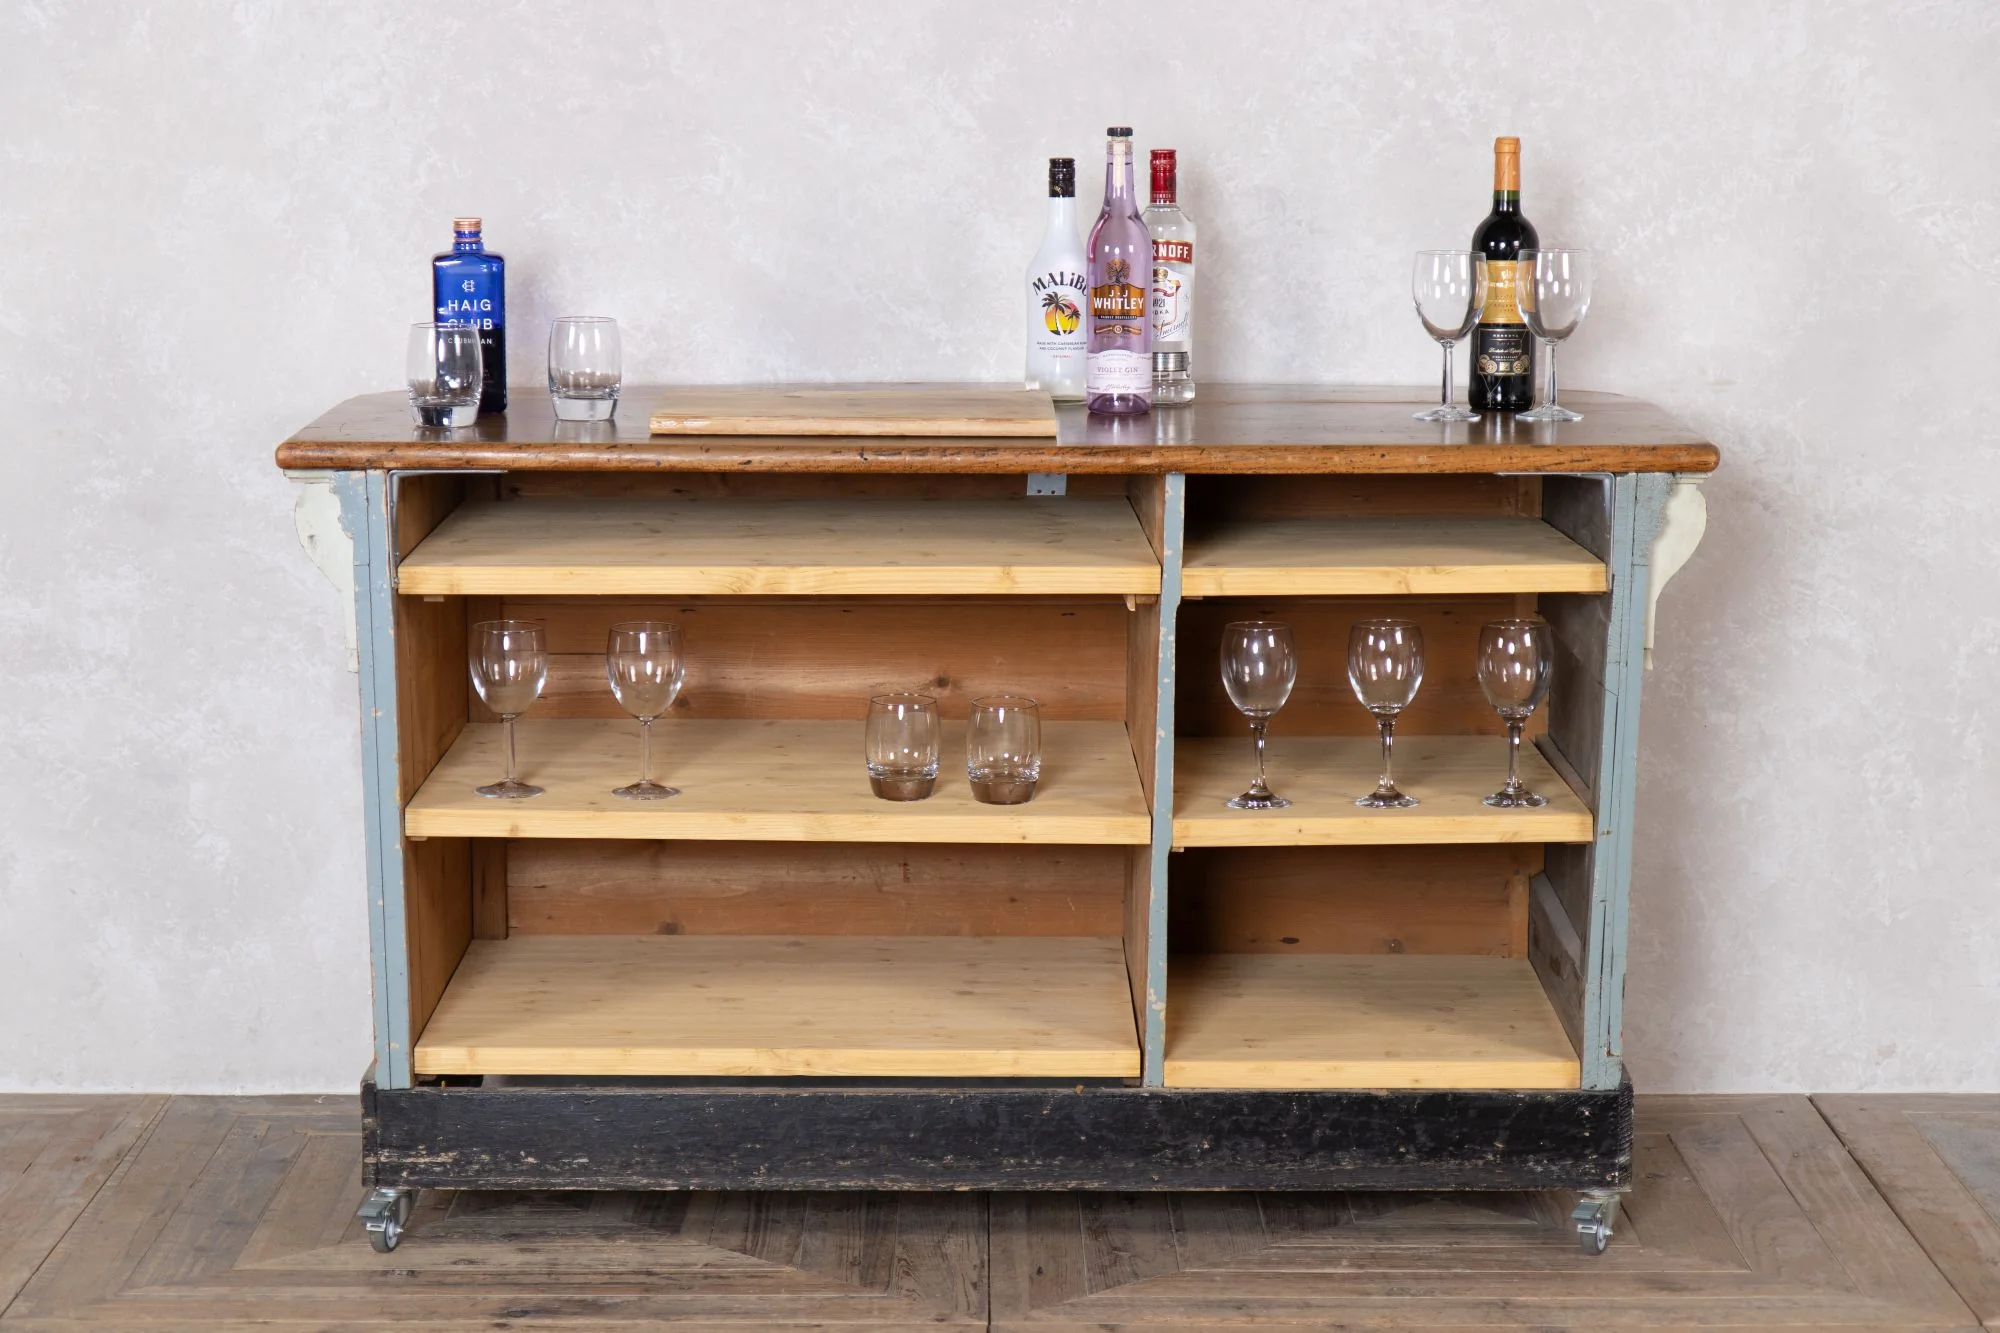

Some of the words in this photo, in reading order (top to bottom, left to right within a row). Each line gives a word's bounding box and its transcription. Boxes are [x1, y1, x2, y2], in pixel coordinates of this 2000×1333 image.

[1152, 244, 1189, 259] RNOFF
[448, 299, 492, 311] HAIG
[1093, 297, 1145, 310] WHITLEY
[447, 318, 493, 330] CLUB
